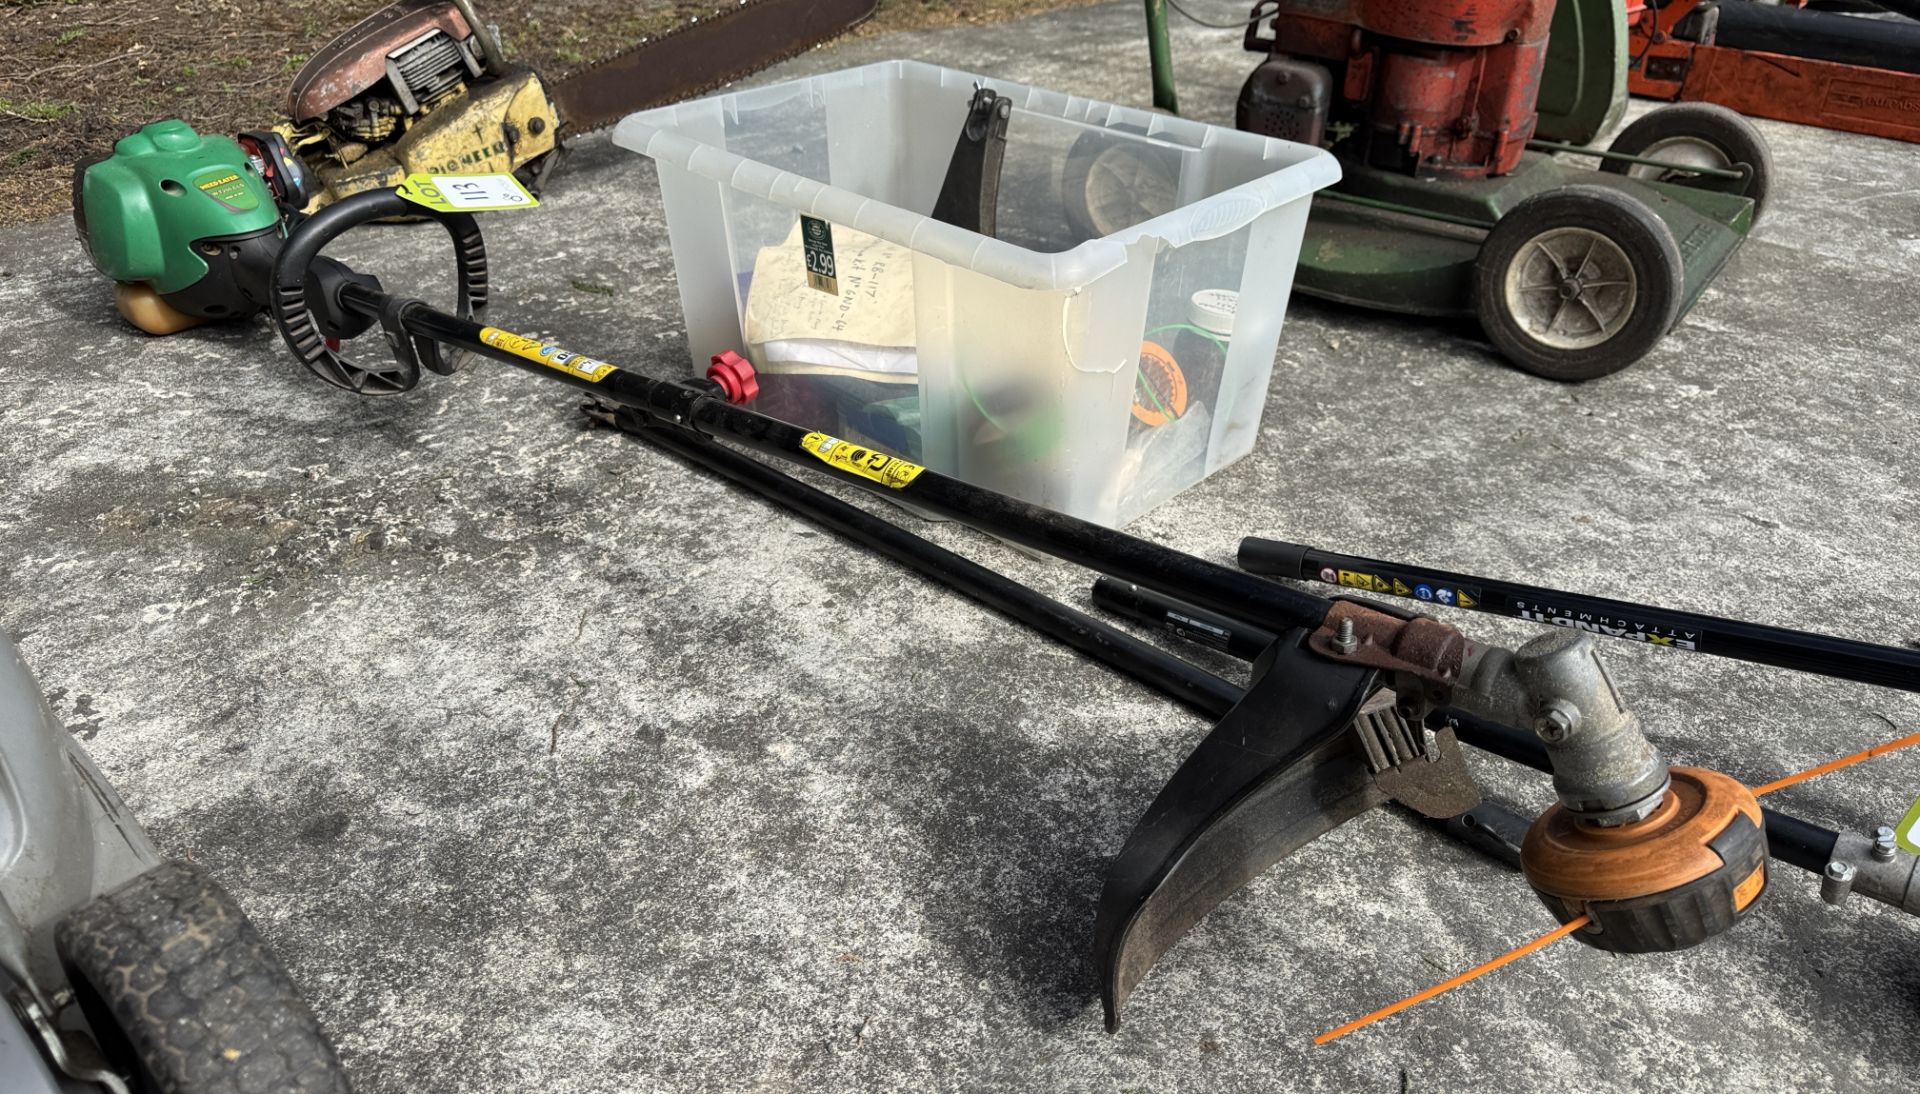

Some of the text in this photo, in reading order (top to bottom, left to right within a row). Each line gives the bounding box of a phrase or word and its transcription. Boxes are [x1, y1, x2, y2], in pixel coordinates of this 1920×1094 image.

[413, 180, 446, 205] LOT
[452, 182, 489, 200] 113
[806, 250, 834, 277] £2.99
[1516, 601, 1695, 639] ATTACHMENTS
